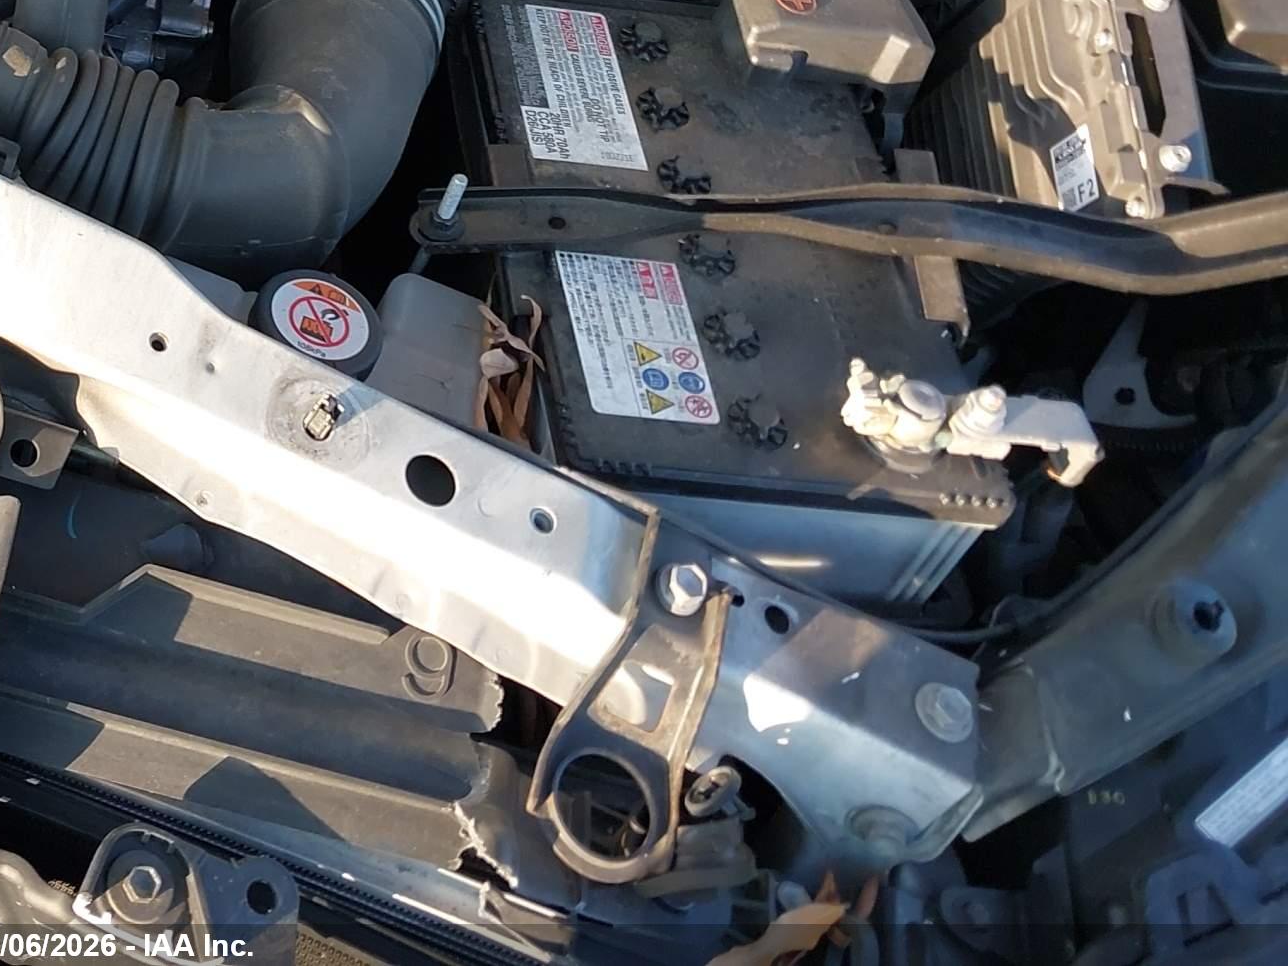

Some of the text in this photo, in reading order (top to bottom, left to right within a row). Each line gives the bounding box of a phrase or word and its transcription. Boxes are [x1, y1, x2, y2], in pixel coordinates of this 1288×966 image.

[560, 20, 577, 50] POISON
[592, 23, 610, 55] DANGER
[524, 109, 544, 146] D26(JIS)
[537, 110, 552, 131] CCA
[593, 111, 606, 127] NOT
[549, 112, 571, 159] 20HR 70Ah
[598, 129, 610, 142] TIP
